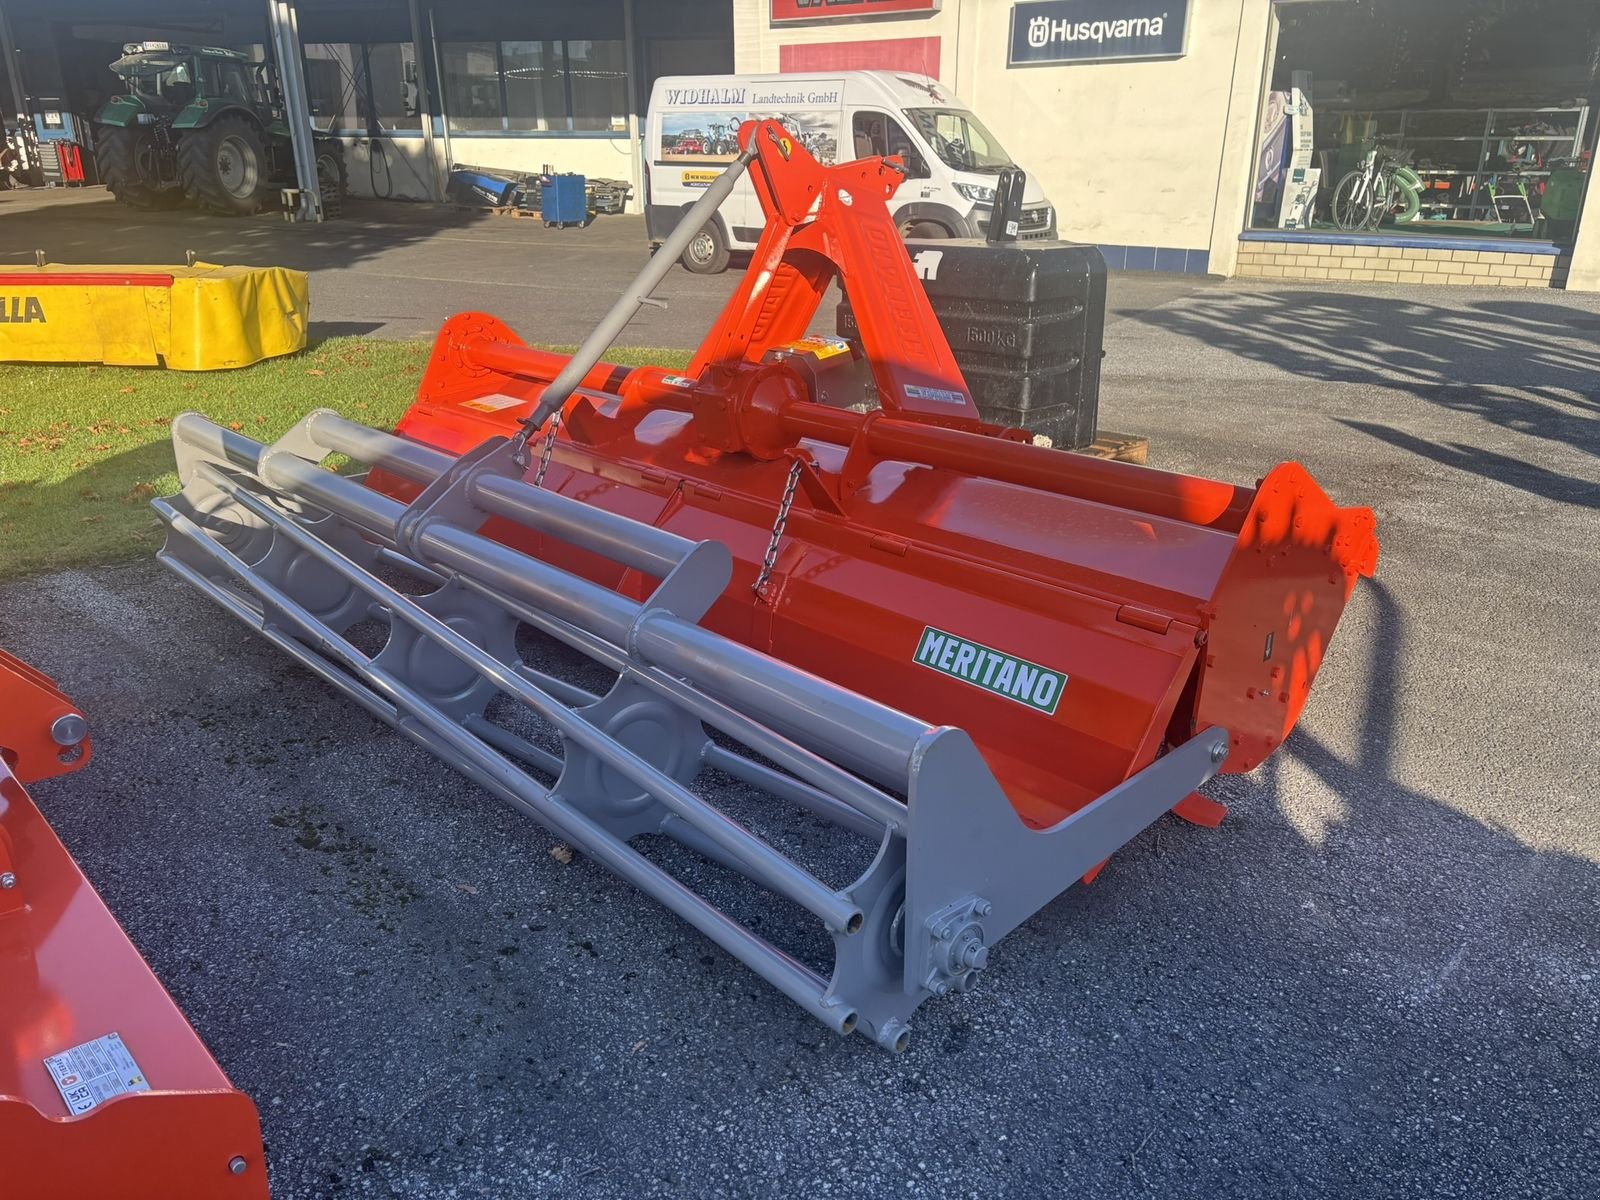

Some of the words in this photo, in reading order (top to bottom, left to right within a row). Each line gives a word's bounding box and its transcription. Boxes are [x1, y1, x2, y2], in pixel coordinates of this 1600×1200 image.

[1051, 16, 1164, 43] Husqvarna
[665, 88, 746, 105] WIDHALM
[752, 93, 805, 104] Landtechnik
[807, 91, 838, 104] GmbH
[918, 631, 1058, 706] MERITANO
